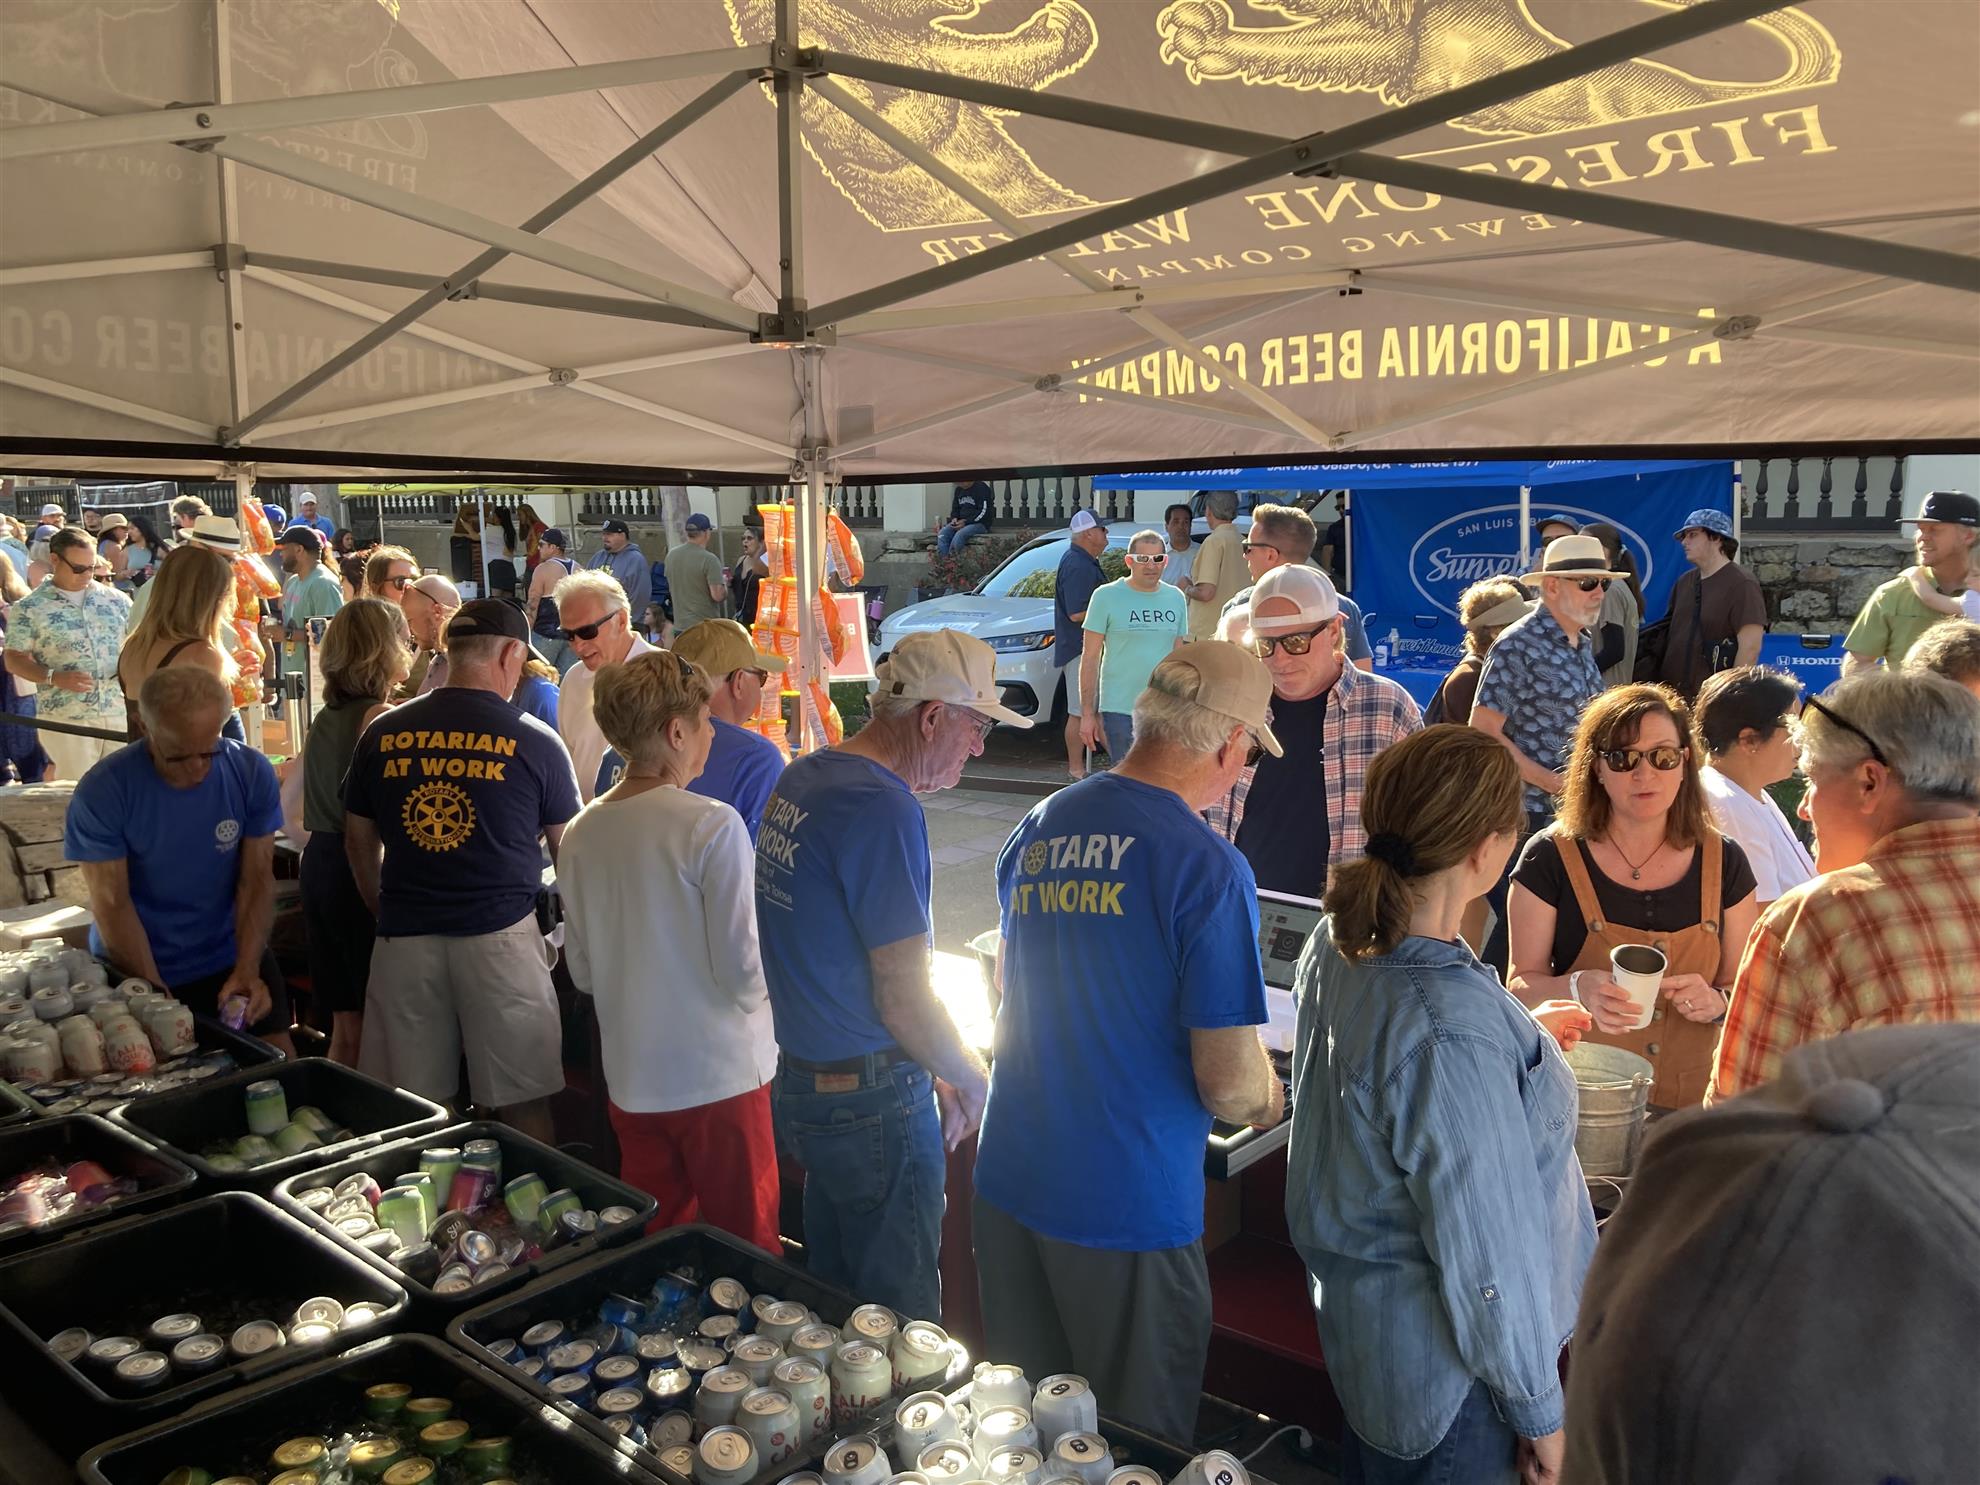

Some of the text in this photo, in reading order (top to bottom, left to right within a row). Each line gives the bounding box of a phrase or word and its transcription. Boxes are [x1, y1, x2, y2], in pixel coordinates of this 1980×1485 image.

[1457, 523, 1480, 538] SAN
[1485, 518, 1514, 530] LUIS
[1129, 610, 1176, 623] AERO
[1792, 657, 1843, 666] HOND
[380, 731, 517, 757] ROTARIAN
[383, 758, 507, 781] AT WORK
[424, 788, 455, 797] ROTARY
[765, 792, 809, 833] TARY
[1010, 879, 1126, 916] AT WORK
